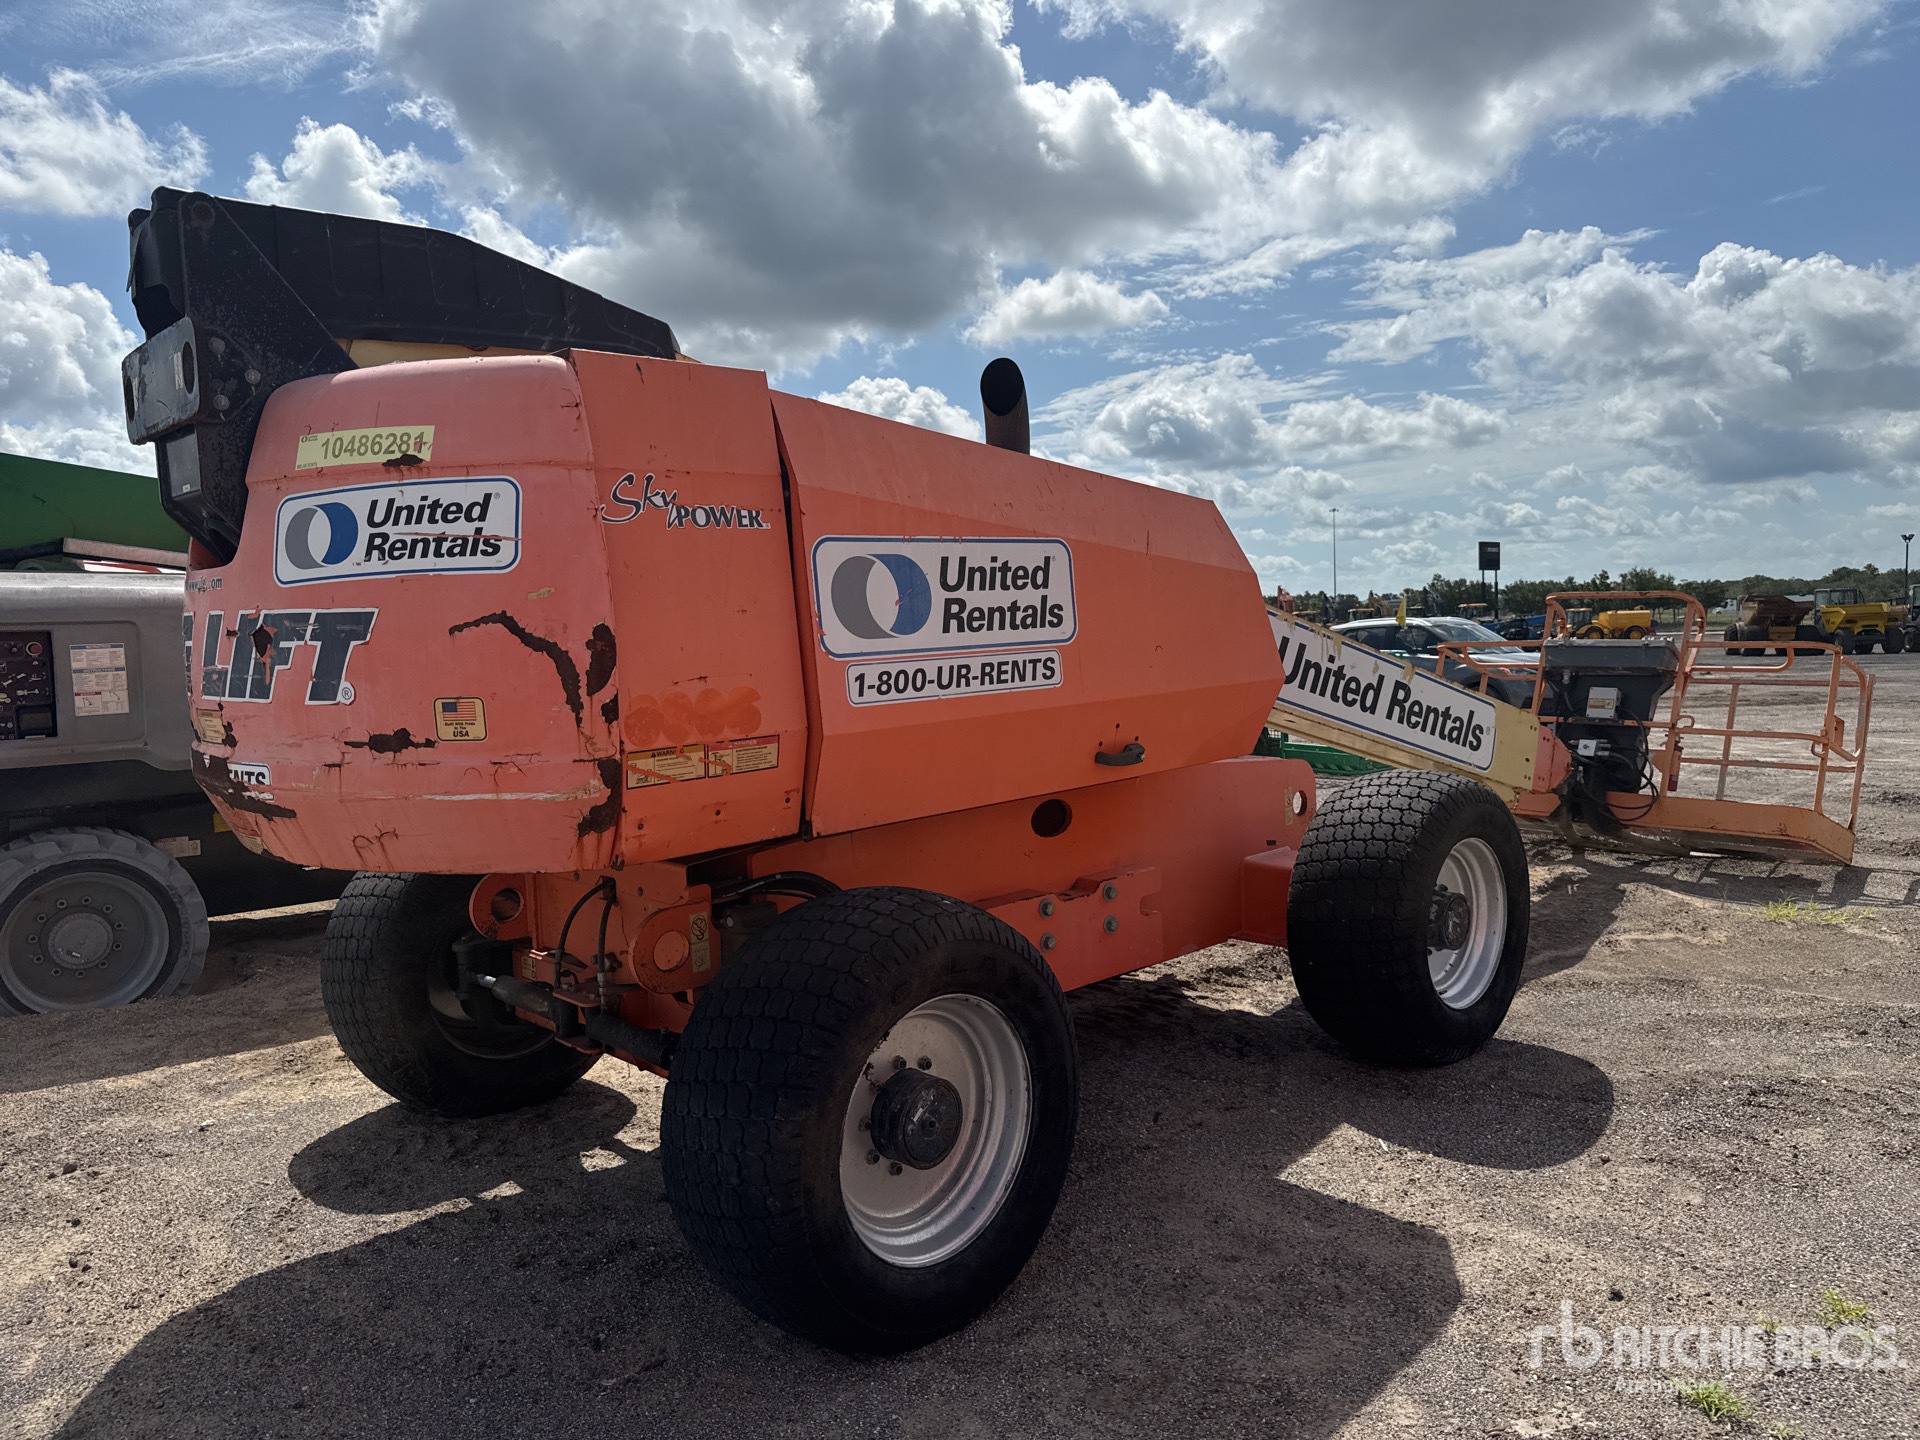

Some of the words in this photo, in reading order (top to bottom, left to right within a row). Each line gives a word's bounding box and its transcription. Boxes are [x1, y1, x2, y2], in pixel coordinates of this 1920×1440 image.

[321, 431, 424, 460] 10486281
[366, 493, 493, 528] United
[364, 527, 503, 563] Rentals
[939, 556, 1052, 592] United
[941, 595, 1064, 634] Rentals
[202, 608, 380, 705] LIFT
[853, 656, 1057, 698] 1-800-UR-RENTS
[1278, 636, 1385, 716] United
[1385, 680, 1484, 752] Rentals
